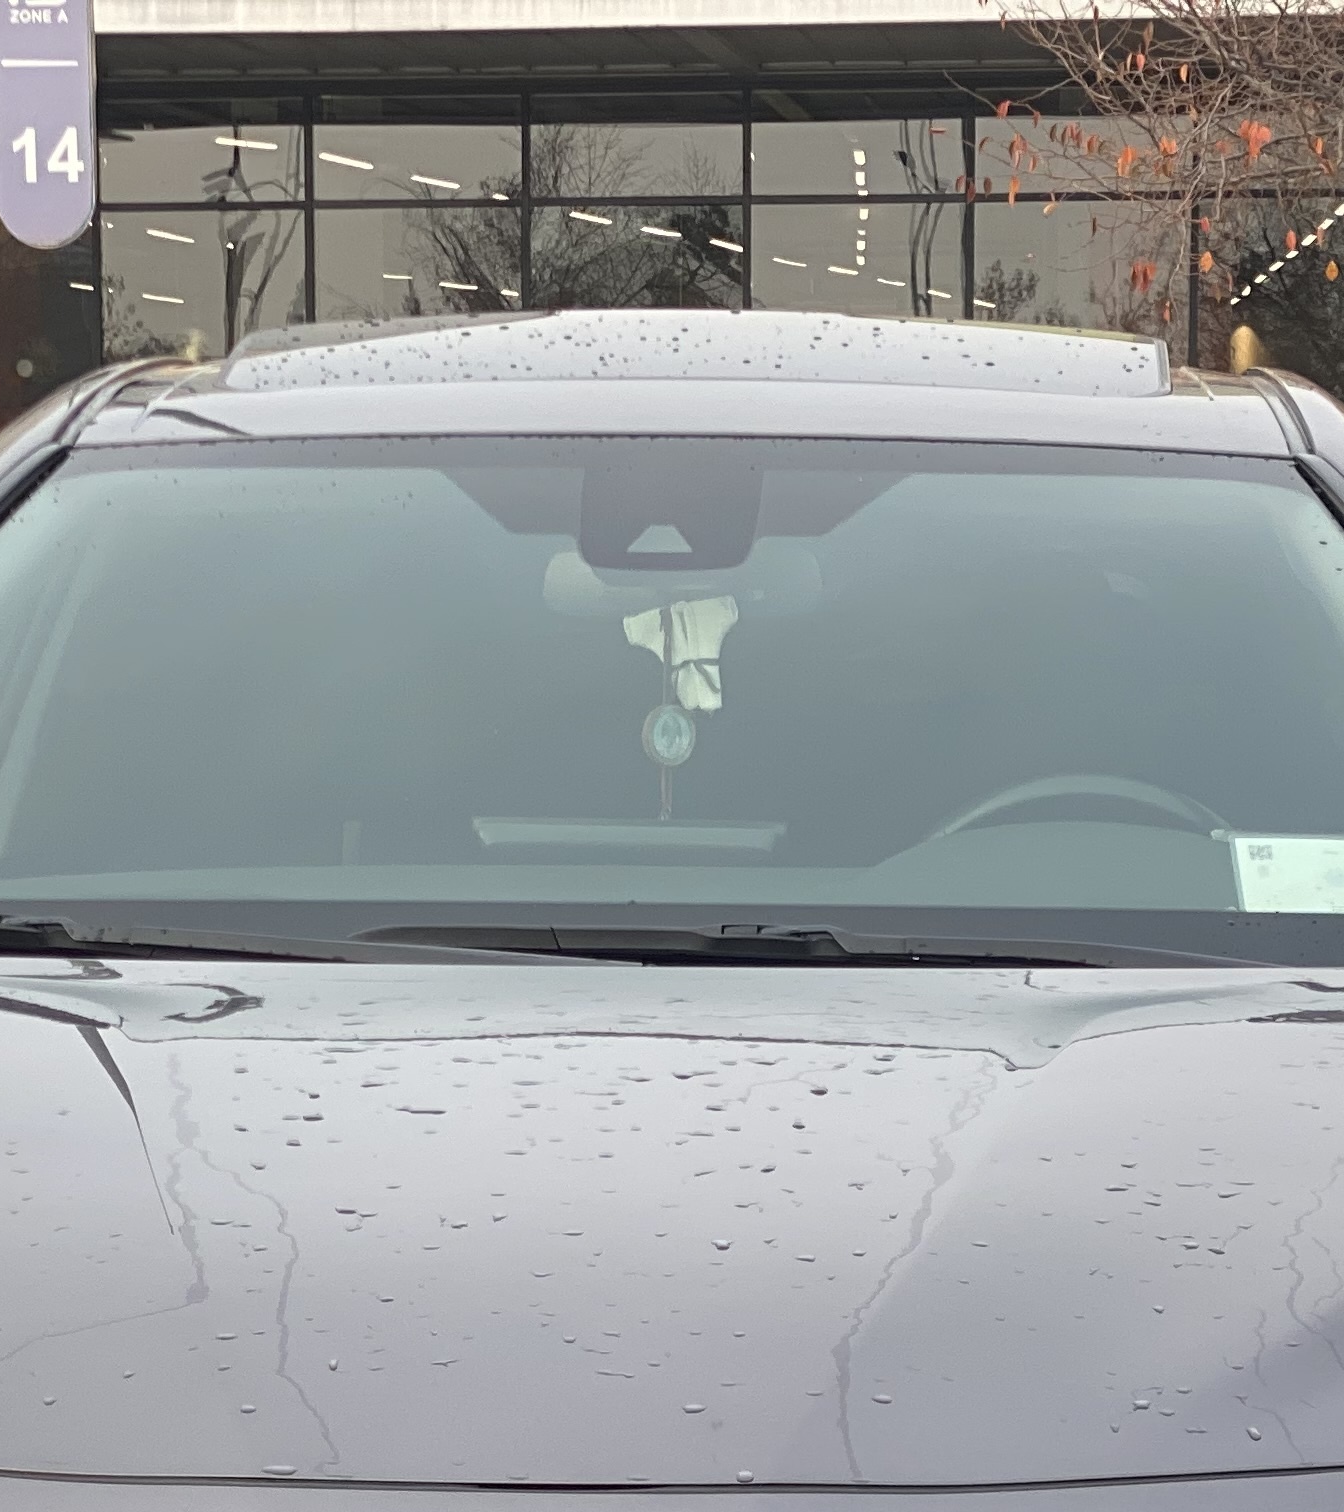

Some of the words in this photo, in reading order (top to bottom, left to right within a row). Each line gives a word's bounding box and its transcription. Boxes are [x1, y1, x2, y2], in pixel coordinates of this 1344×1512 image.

[9, 8, 52, 24] ZONE
[57, 8, 69, 24] A
[12, 126, 85, 184] 14
